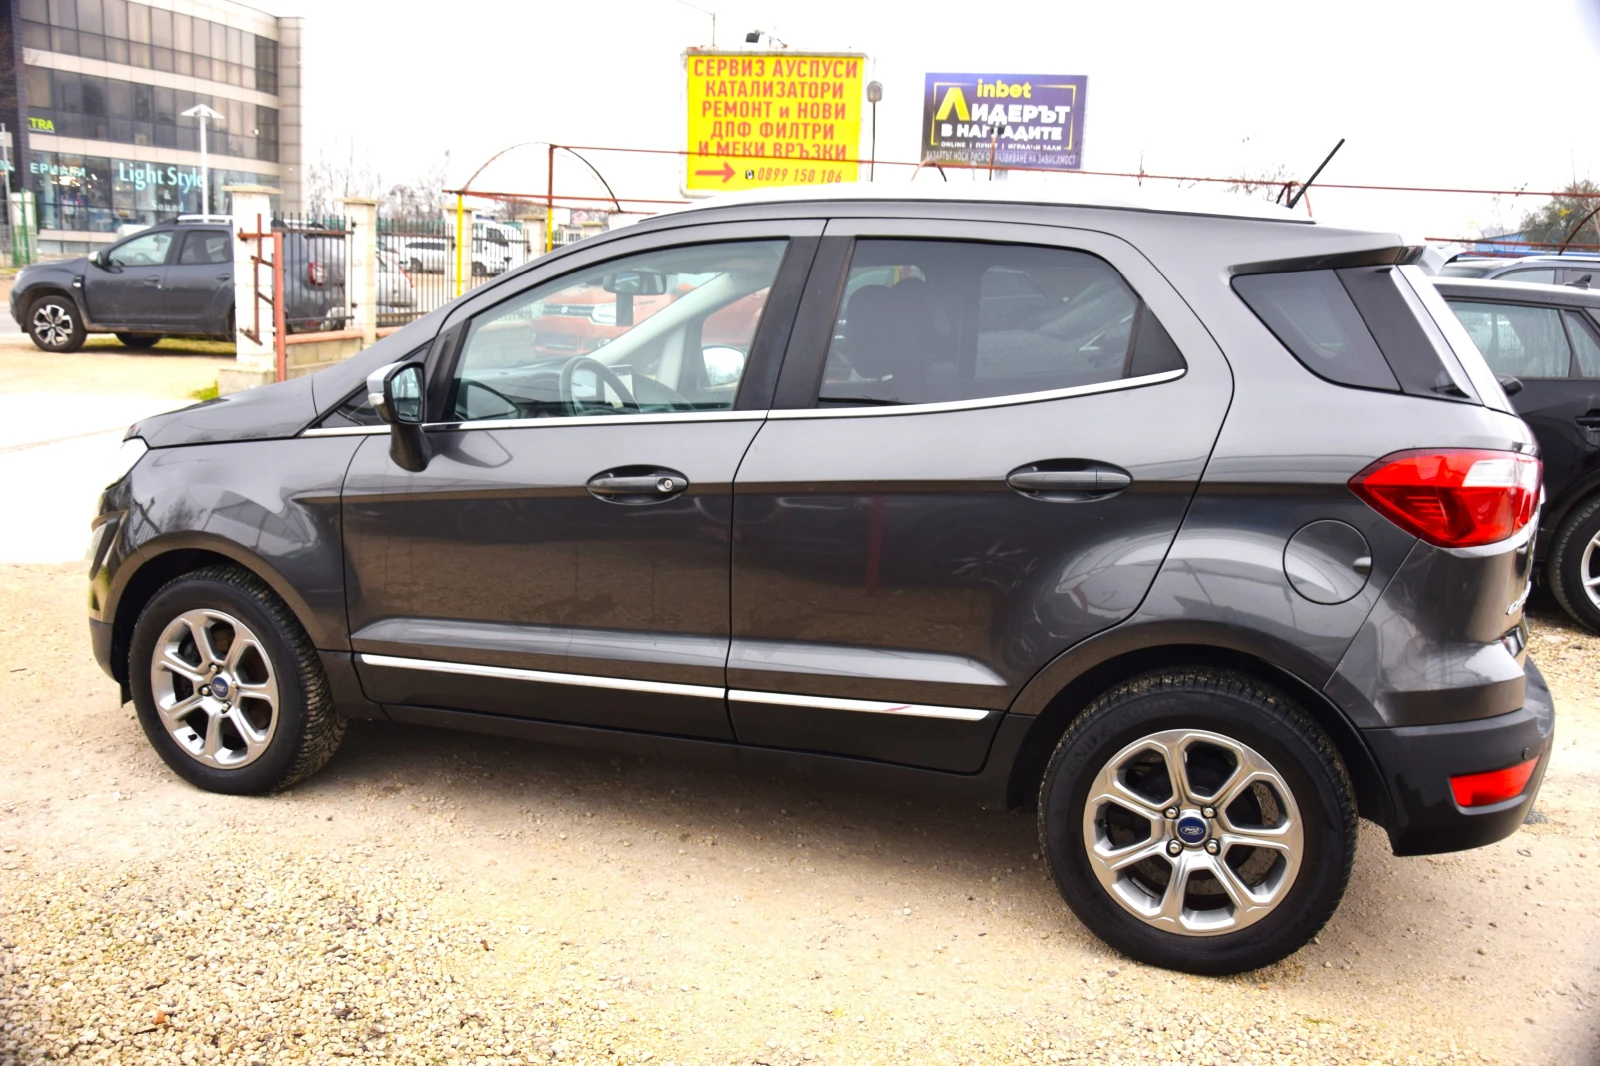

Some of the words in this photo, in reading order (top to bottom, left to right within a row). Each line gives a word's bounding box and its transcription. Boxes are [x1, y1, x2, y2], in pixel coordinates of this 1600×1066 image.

[694, 59, 766, 77] СЕРВИЗ
[772, 60, 858, 79] АУСПУСИ
[705, 80, 844, 99] КАТАЛИЗАТОРИ
[976, 78, 1032, 99] inbet
[702, 100, 773, 118] РЕМОНТ
[797, 102, 846, 120] НОВИ
[710, 121, 752, 141] ДПФ
[759, 121, 835, 141] ФИЛТРИ
[941, 123, 954, 137] В
[956, 123, 1062, 142] НАГАДИТЕ
[698, 141, 709, 157] И
[716, 141, 765, 158] МЕКИ
[773, 142, 847, 161] ВРЪЗКИ
[119, 162, 164, 190] Light
[167, 166, 203, 194] Style
[758, 167, 788, 181] 0899
[794, 168, 816, 183] 150
[821, 169, 842, 184] 106
[151, 199, 184, 213] Sound
